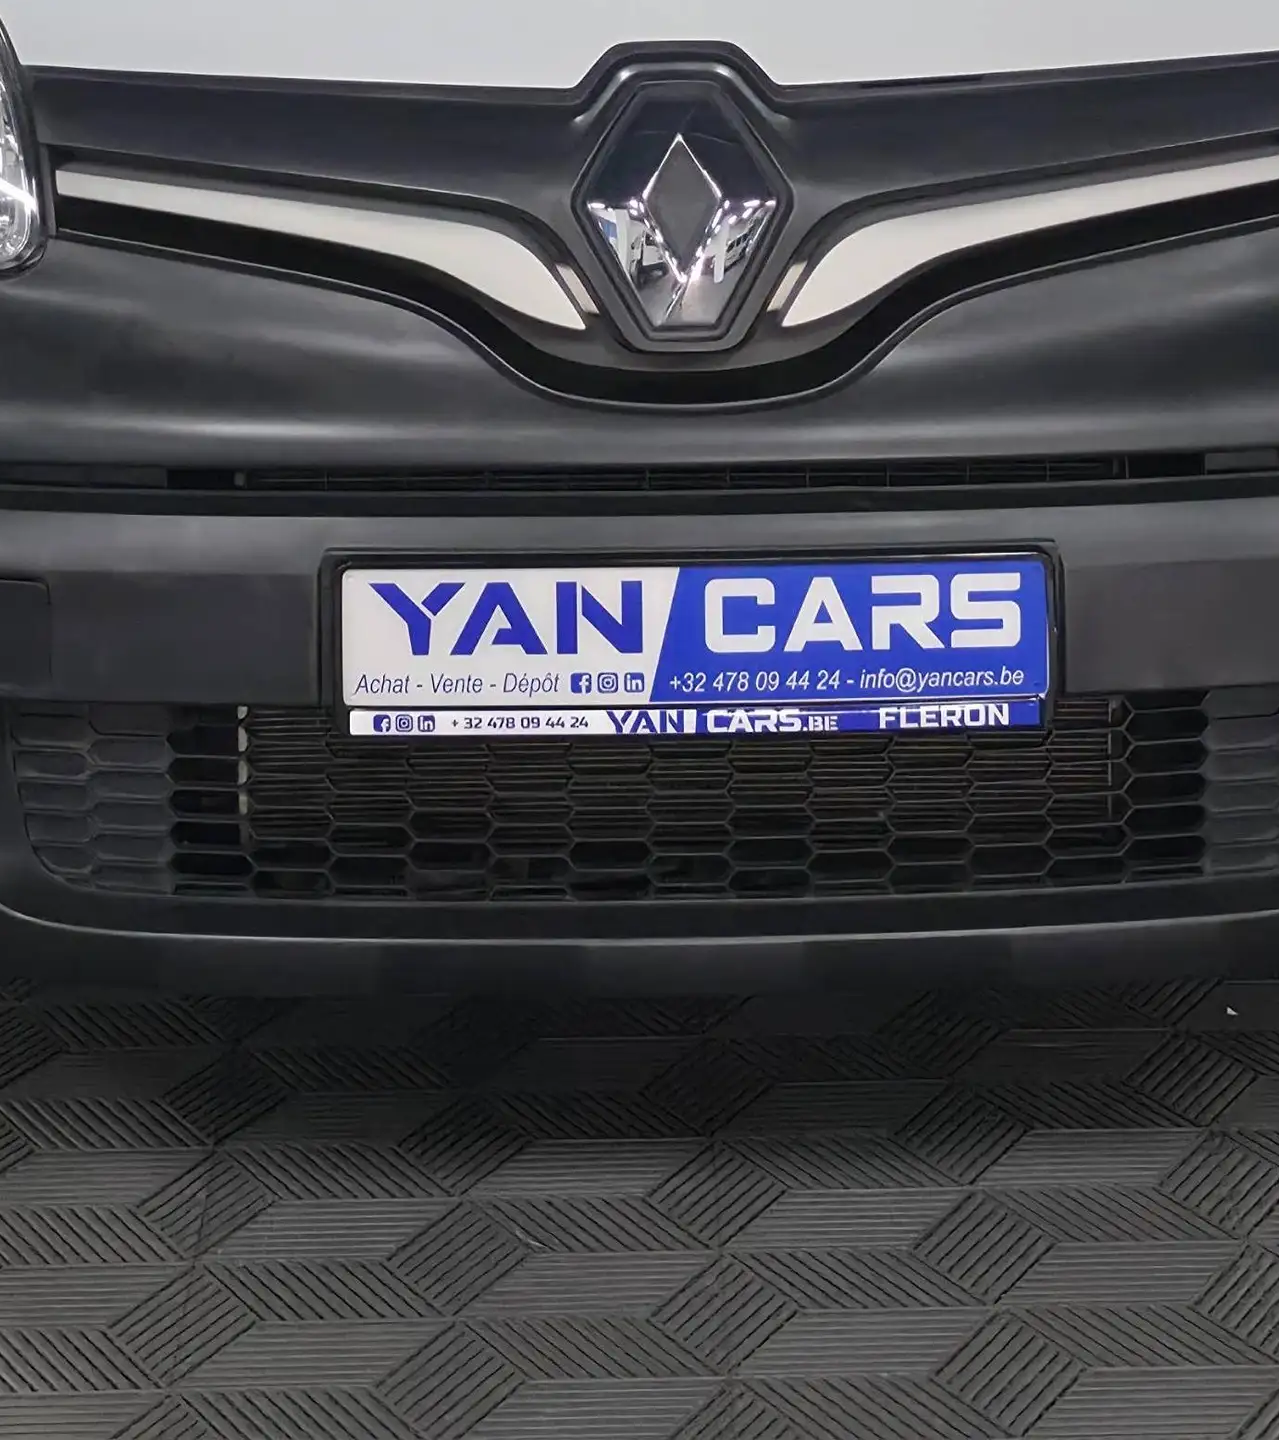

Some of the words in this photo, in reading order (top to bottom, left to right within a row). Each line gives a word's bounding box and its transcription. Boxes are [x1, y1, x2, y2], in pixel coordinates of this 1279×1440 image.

[368, 580, 643, 656] YAN
[704, 572, 1021, 654] CARS
[354, 673, 410, 694] Achat
[430, 673, 483, 694] Vente
[503, 672, 559, 698] Dépôt
[669, 671, 705, 693] +32
[712, 671, 749, 692] 478
[755, 670, 780, 691] 09
[786, 670, 811, 691] 44
[817, 669, 841, 690] 24
[860, 666, 1024, 693] info@yancars.be
[464, 717, 483, 730] 32
[487, 717, 516, 730] 478
[521, 716, 540, 730] 09
[545, 716, 566, 729] 44
[570, 716, 589, 729] 24
[606, 710, 684, 734] YAN
[878, 703, 1010, 730] FLERON
